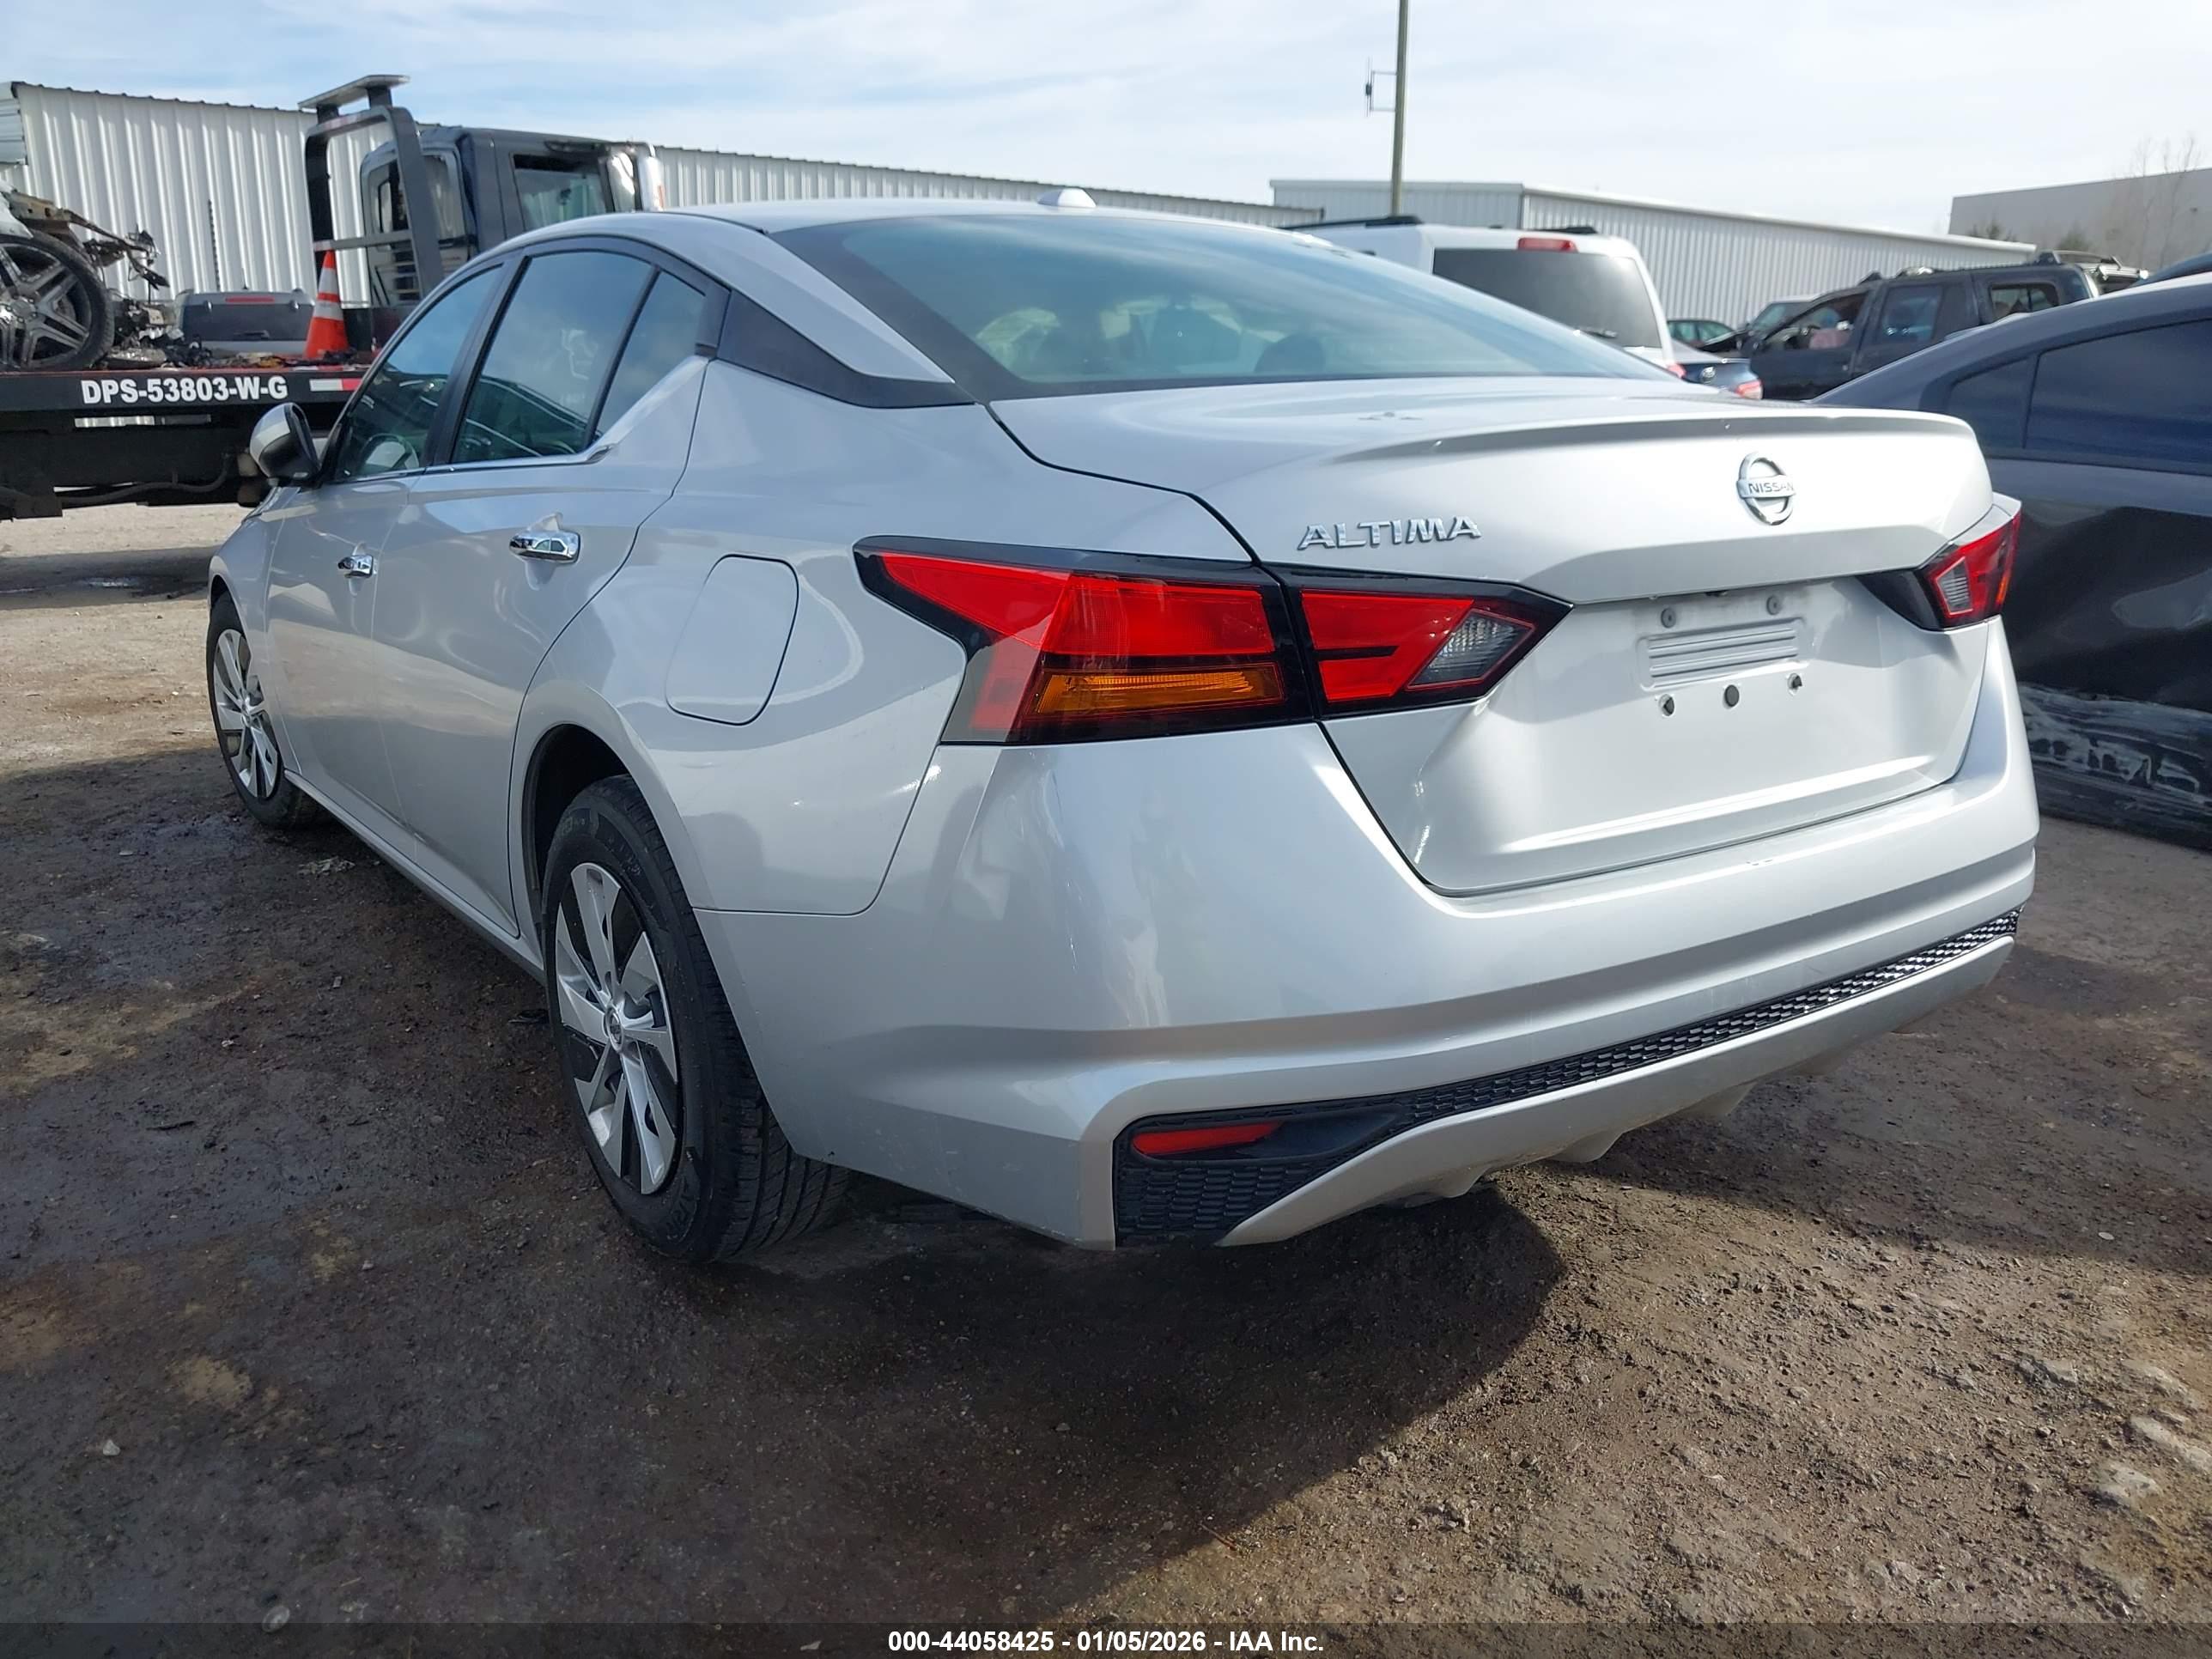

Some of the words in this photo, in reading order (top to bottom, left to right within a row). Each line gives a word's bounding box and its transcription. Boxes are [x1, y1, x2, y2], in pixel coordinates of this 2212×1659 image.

[81, 375, 289, 404] DPS-53803-W-G
[1747, 481, 1795, 495] NISSAN
[1297, 515, 1482, 551] ALTIMA
